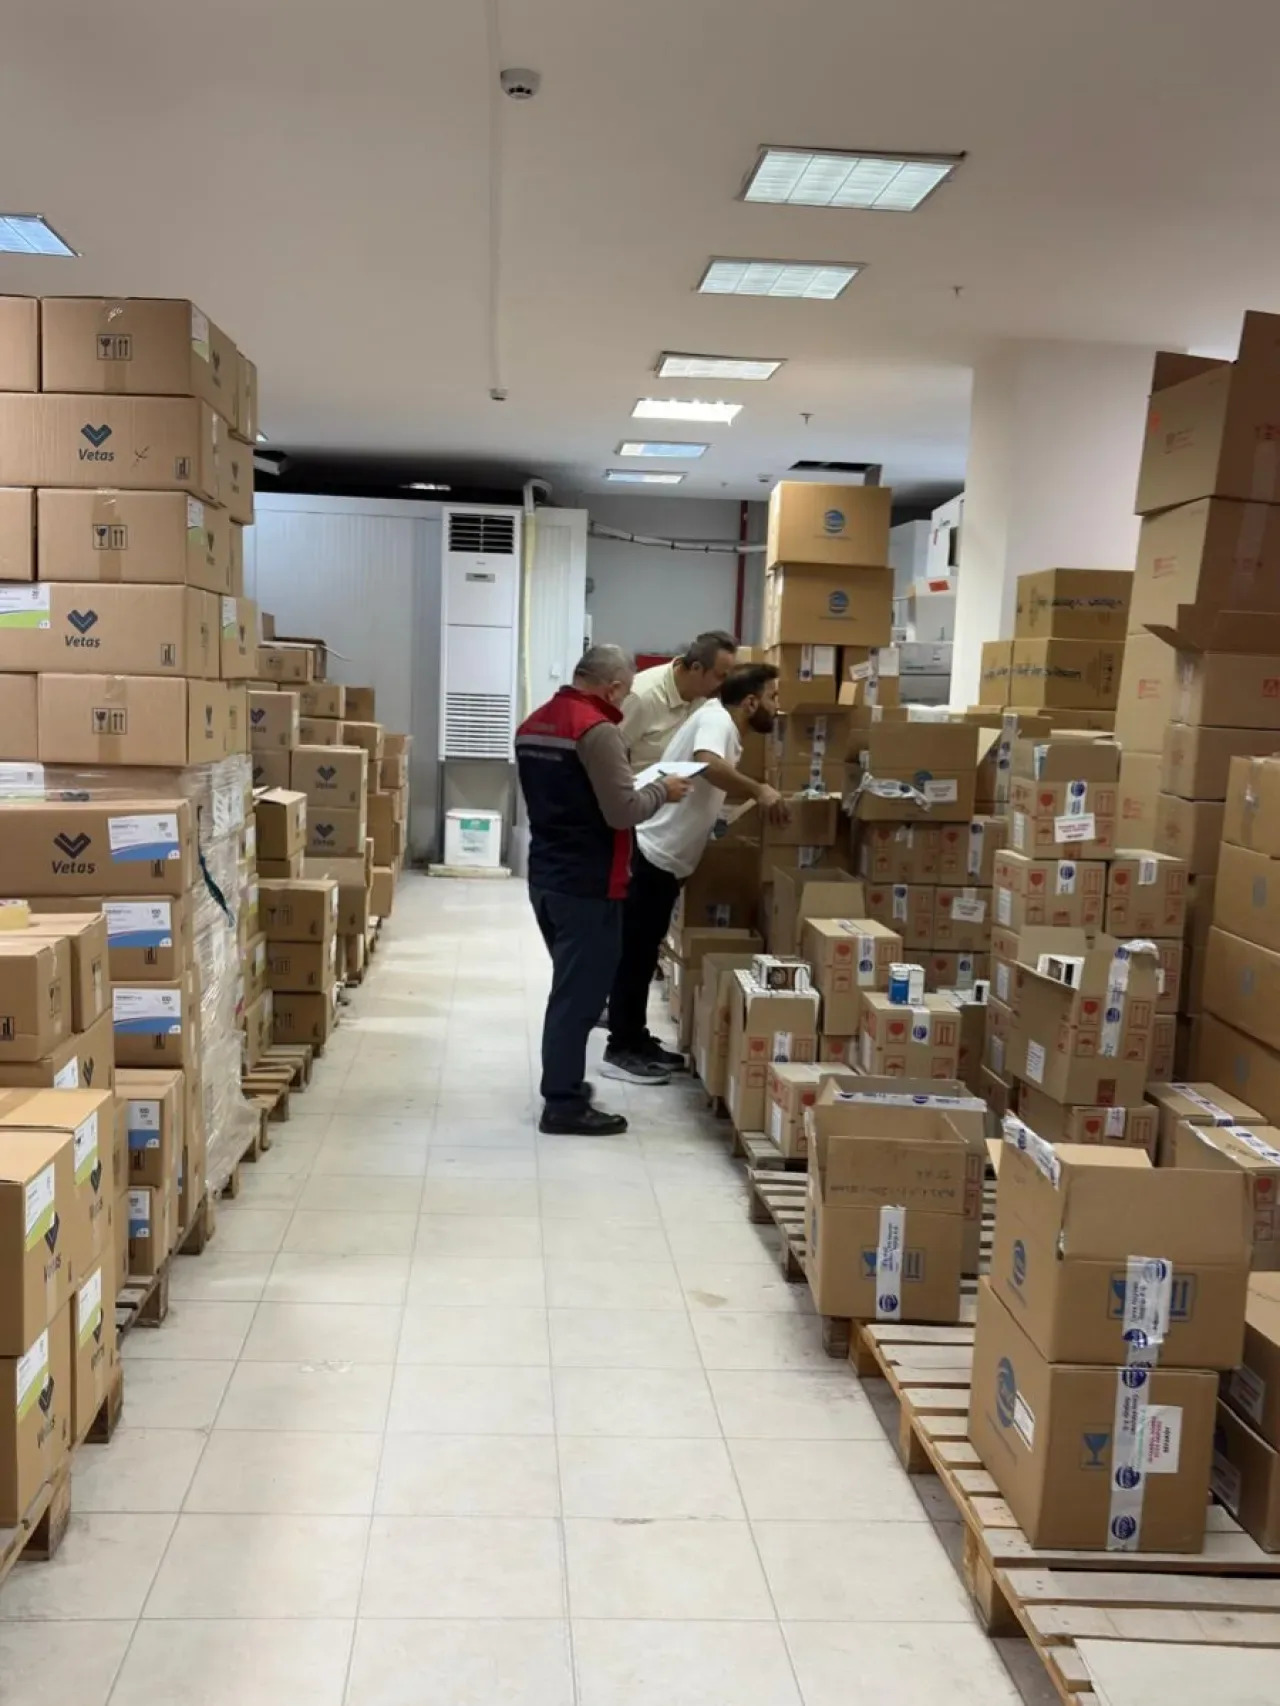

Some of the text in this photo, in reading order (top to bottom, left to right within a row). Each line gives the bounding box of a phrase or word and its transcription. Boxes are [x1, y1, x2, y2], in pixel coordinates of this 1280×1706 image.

[78, 448, 115, 462] Vetas
[64, 635, 101, 648] Vetas
[52, 861, 96, 874] Vetas
